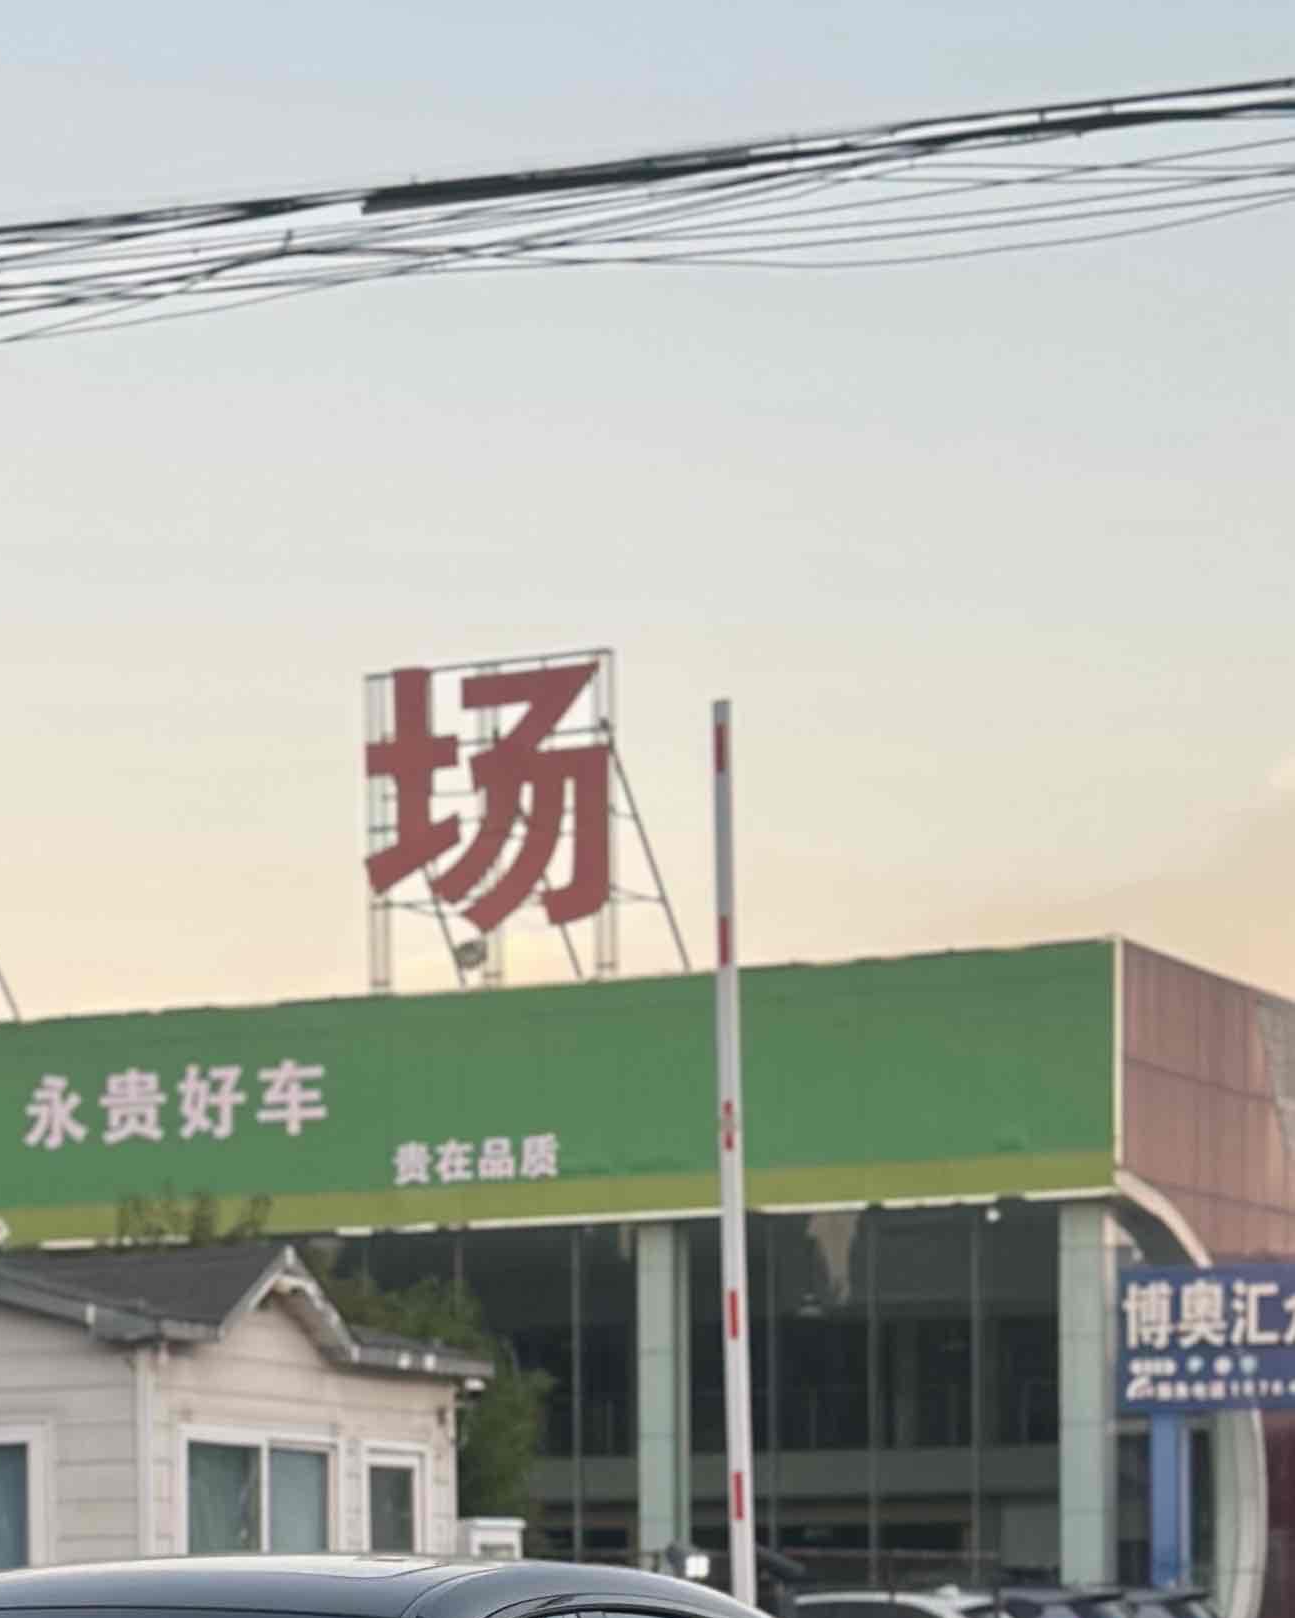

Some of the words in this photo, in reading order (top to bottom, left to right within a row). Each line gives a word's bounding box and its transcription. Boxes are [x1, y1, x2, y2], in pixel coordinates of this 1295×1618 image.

[23, 1059, 326, 1149] 永贵好车
[393, 1133, 558, 1185] 贵在品质
[1122, 1279, 1295, 1349] 博奥汇
